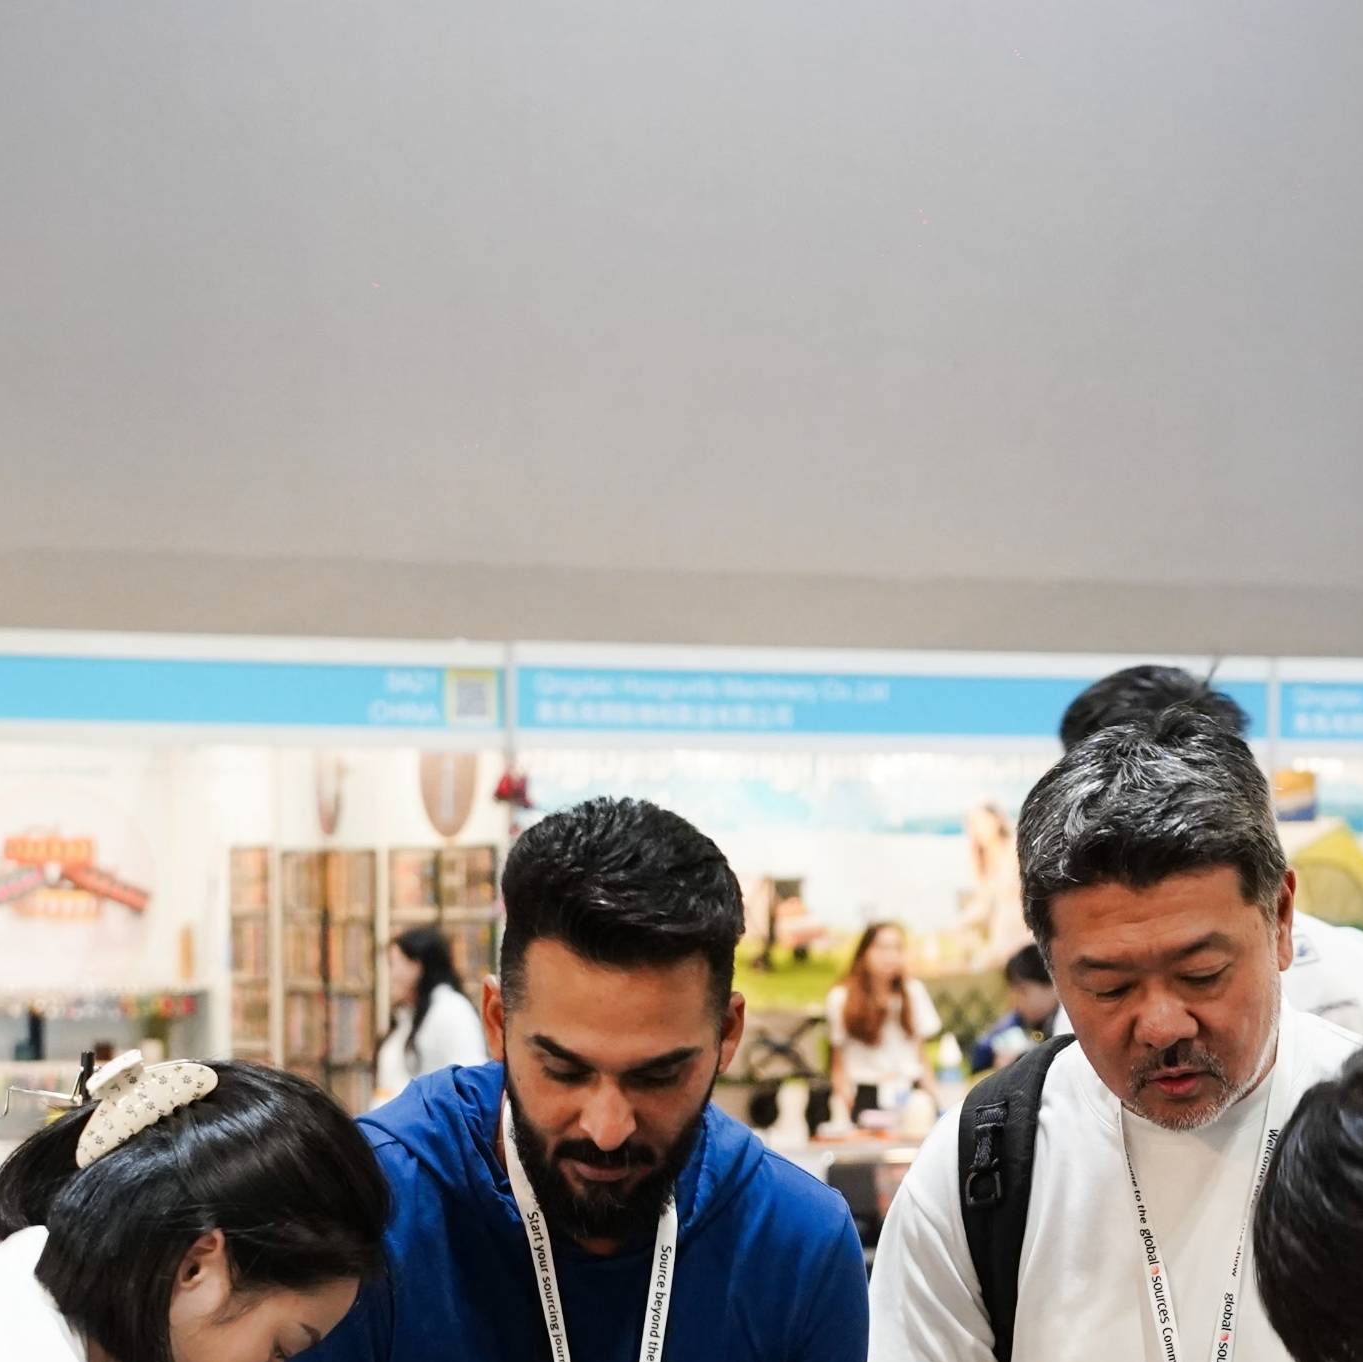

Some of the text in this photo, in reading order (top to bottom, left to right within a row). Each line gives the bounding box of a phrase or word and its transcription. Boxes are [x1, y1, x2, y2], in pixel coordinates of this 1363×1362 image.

[526, 1211, 545, 1242] Start
[534, 1244, 550, 1273] your
[656, 1244, 672, 1289] Source
[1139, 1228, 1160, 1266] global
[1151, 1275, 1170, 1324] sources
[541, 1275, 560, 1331] sourcing
[650, 1291, 668, 1339] beyond
[1221, 1292, 1235, 1331] global
[646, 1340, 659, 1362] the
